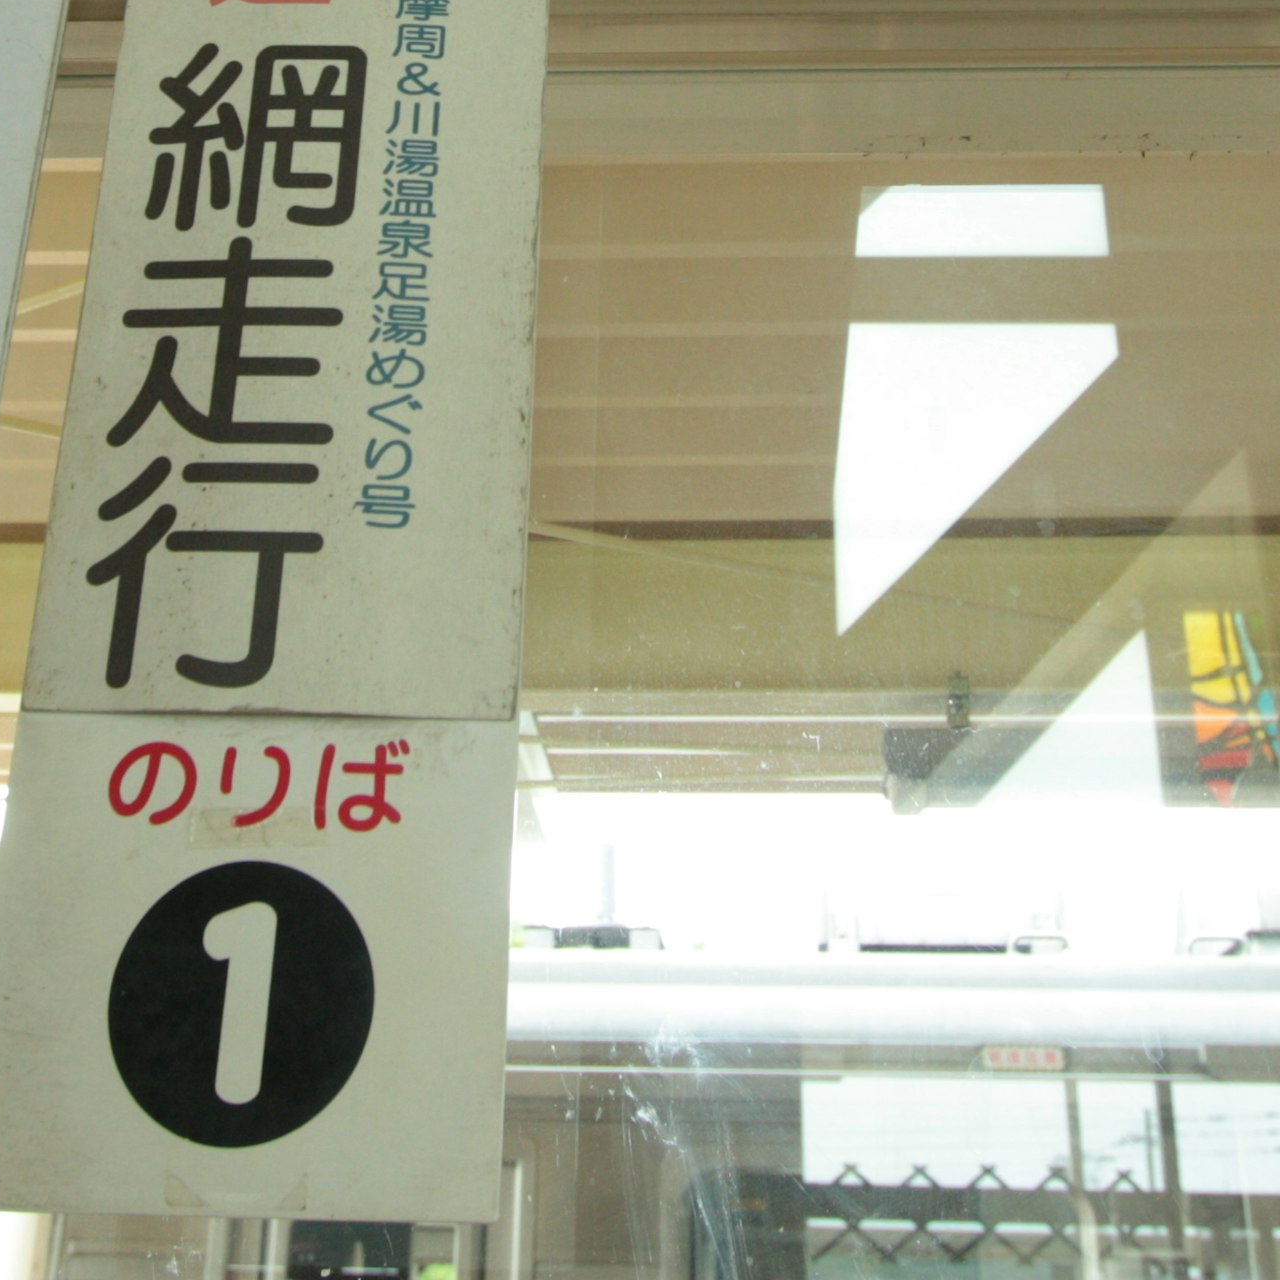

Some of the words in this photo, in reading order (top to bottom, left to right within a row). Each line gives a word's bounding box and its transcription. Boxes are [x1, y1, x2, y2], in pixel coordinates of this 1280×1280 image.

[85, 42, 368, 690] 網走行
[108, 739, 411, 832] のりば
